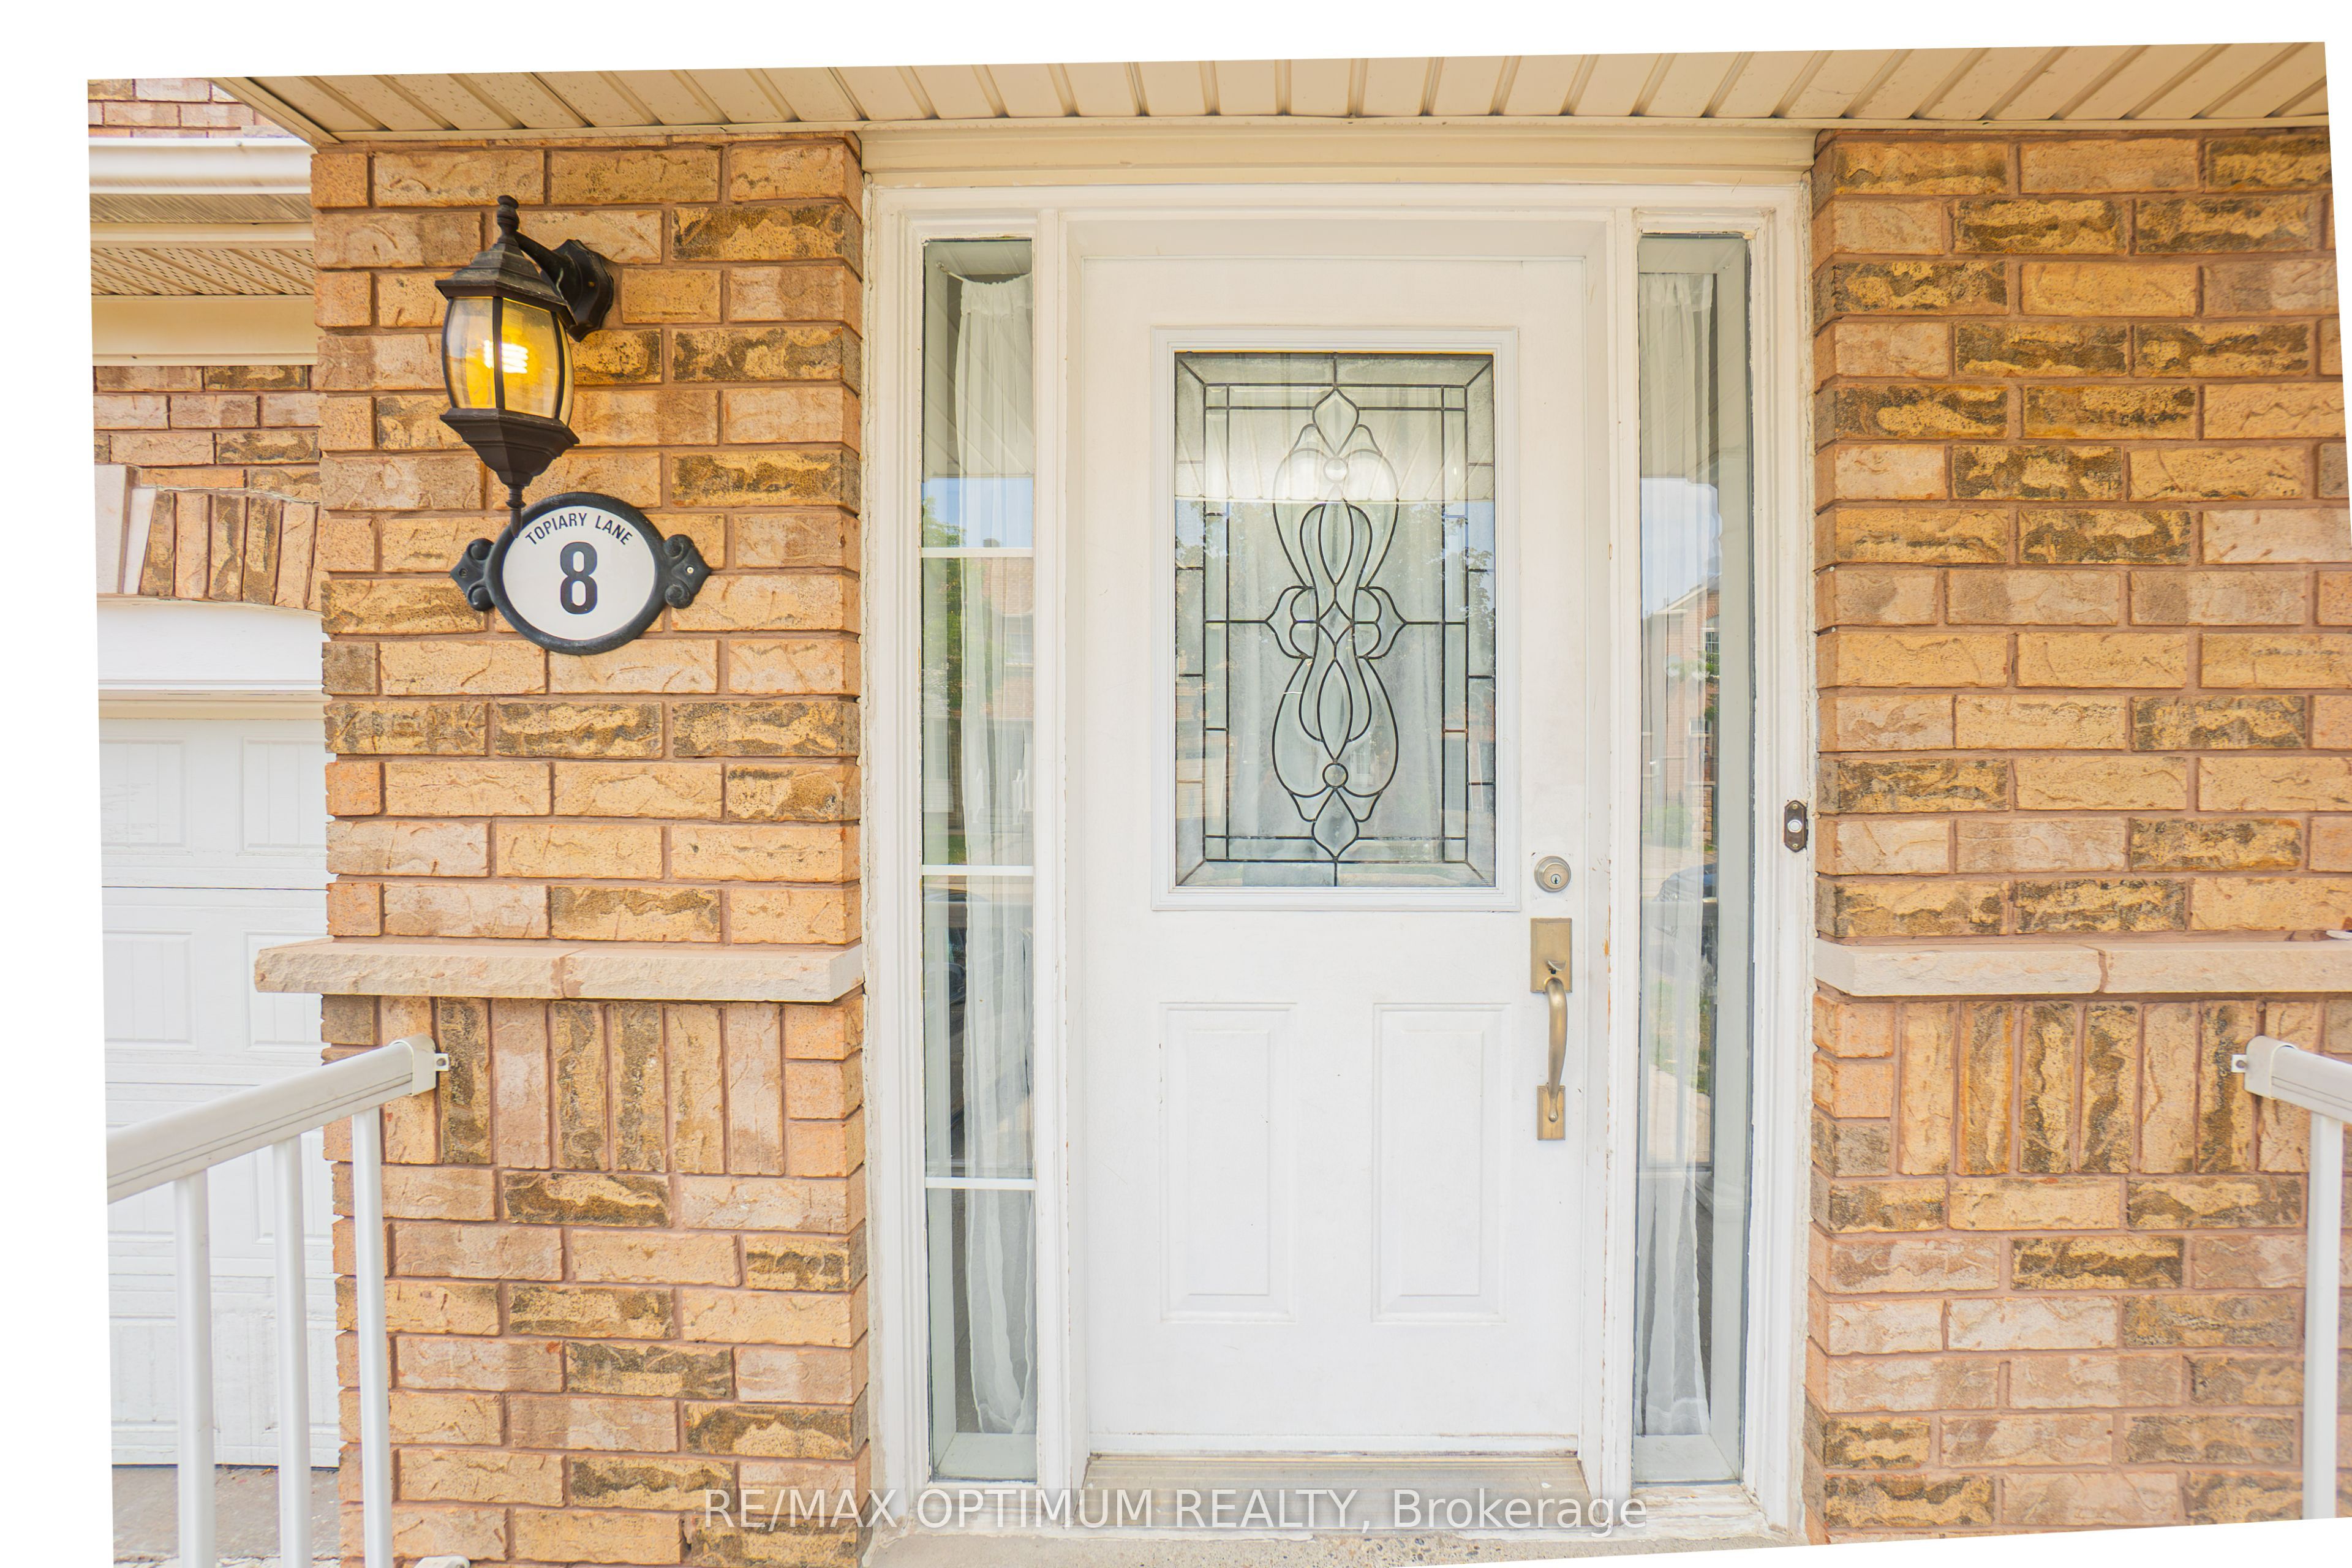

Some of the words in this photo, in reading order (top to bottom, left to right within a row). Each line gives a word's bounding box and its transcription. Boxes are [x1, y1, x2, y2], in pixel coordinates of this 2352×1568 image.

[525, 513, 587, 545] TOPIARY
[595, 515, 633, 546] LANE
[560, 541, 598, 615] 8
